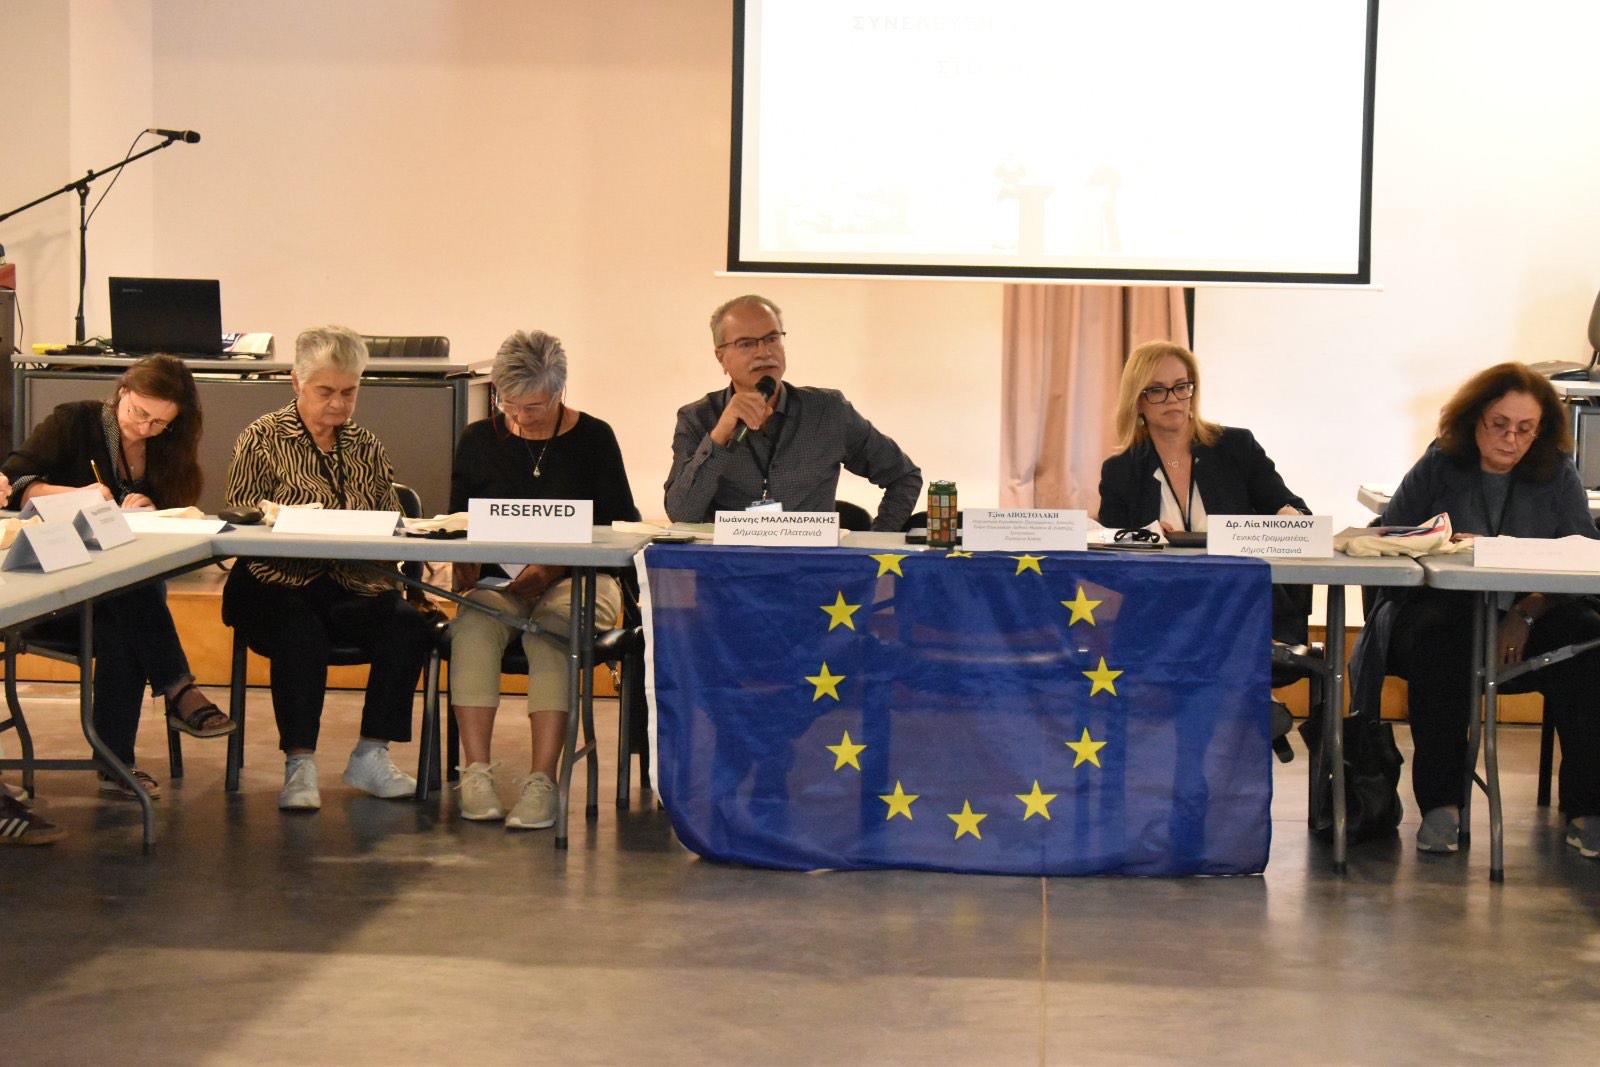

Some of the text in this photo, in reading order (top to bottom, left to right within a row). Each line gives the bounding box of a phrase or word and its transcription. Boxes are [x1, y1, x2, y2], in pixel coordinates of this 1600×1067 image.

[490, 504, 576, 517] RESERVED
[1006, 511, 1059, 519] ΑΠΟΣΤΟΛΑΚΗ
[719, 515, 836, 524] Ιωάννης ΜΑΛΑΝΔΡΑΚΗΣ
[1225, 519, 1315, 529] Δρ. Λία ΝΙΚΟΛΑΟΥ
[732, 528, 822, 537] Δήμαρχος Πλατανιά
[1232, 533, 1260, 542] Γενικός
[1240, 546, 1302, 554] Δήμος Πλατανιά
